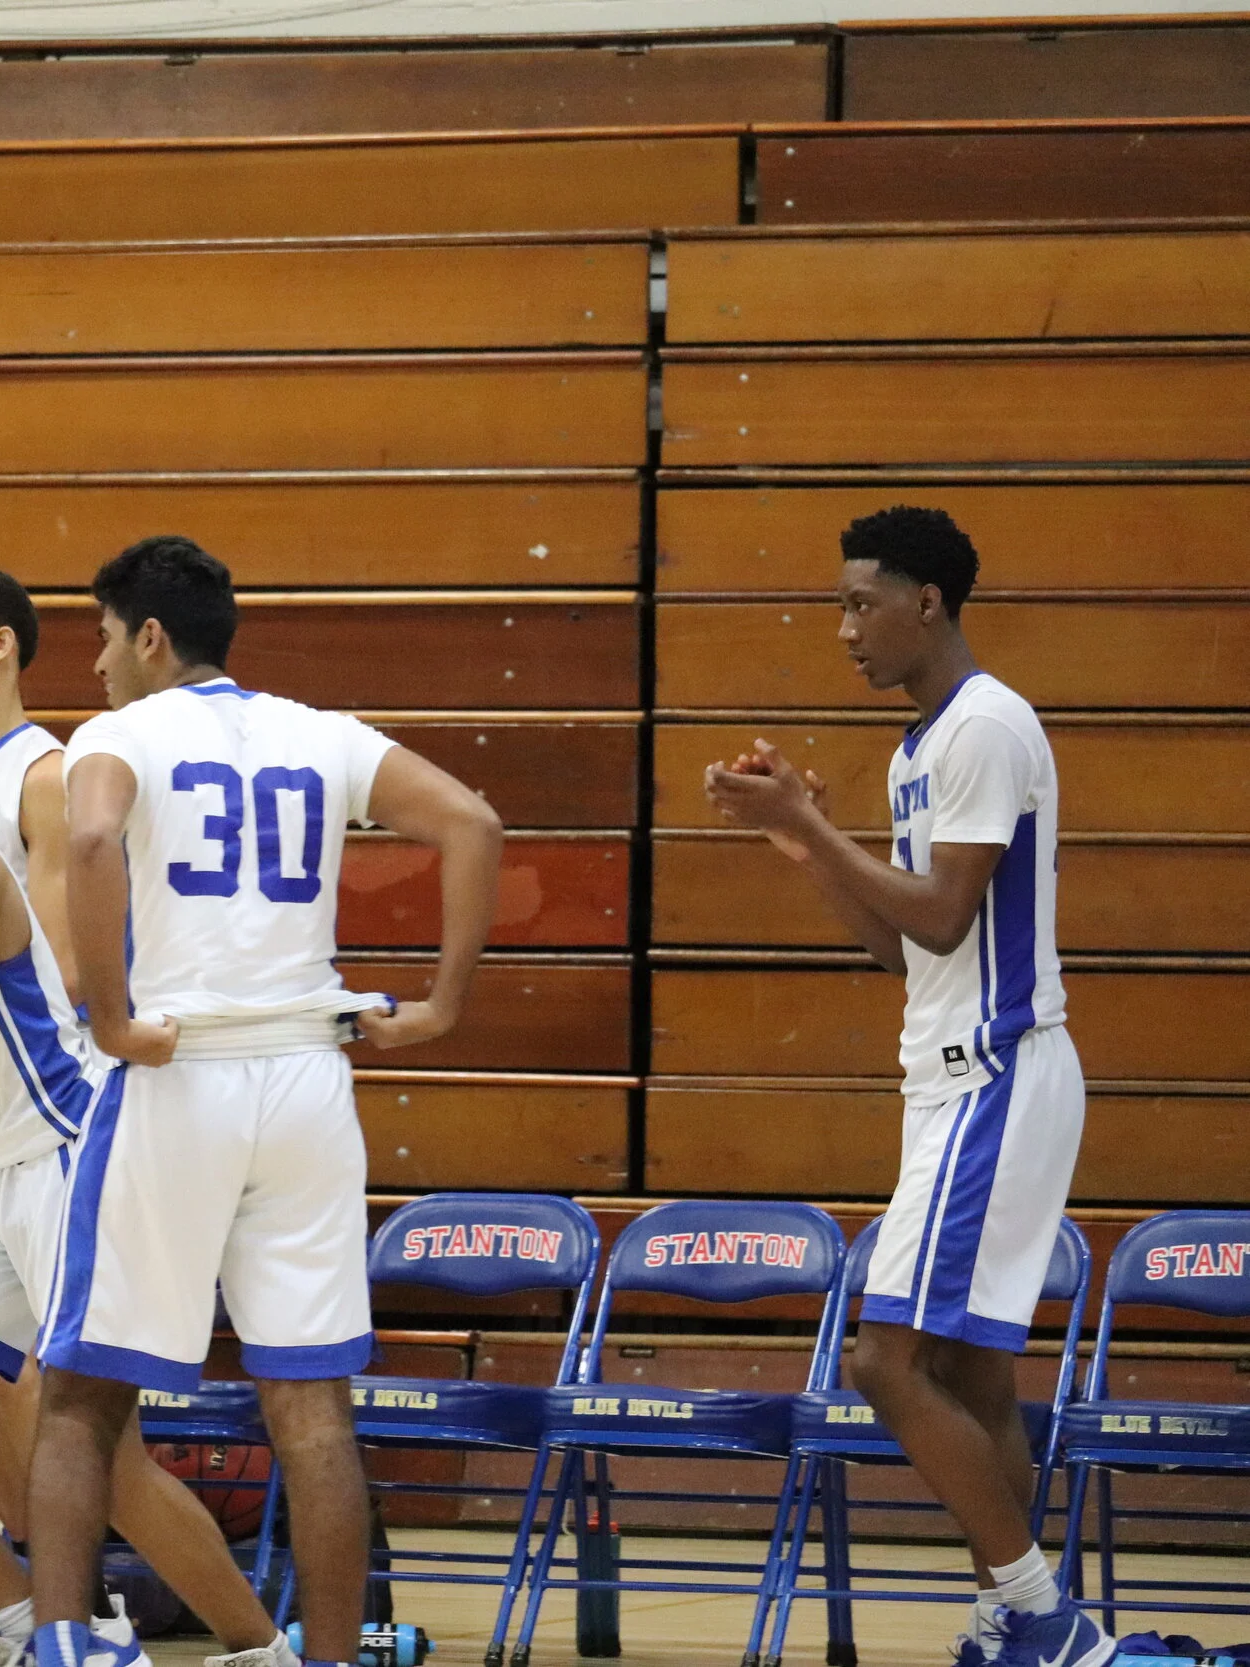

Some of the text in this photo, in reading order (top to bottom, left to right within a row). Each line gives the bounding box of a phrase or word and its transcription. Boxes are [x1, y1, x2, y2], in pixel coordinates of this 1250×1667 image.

[167, 760, 324, 904] 30
[948, 1049, 958, 1060] M
[403, 1224, 563, 1264] STANTON
[644, 1232, 808, 1269] STANTON
[1145, 1243, 1250, 1281] STAN
[372, 1389, 439, 1410] DEVILS
[572, 1398, 694, 1419] BLUE DEVILS
[1101, 1415, 1152, 1434] BLUE
